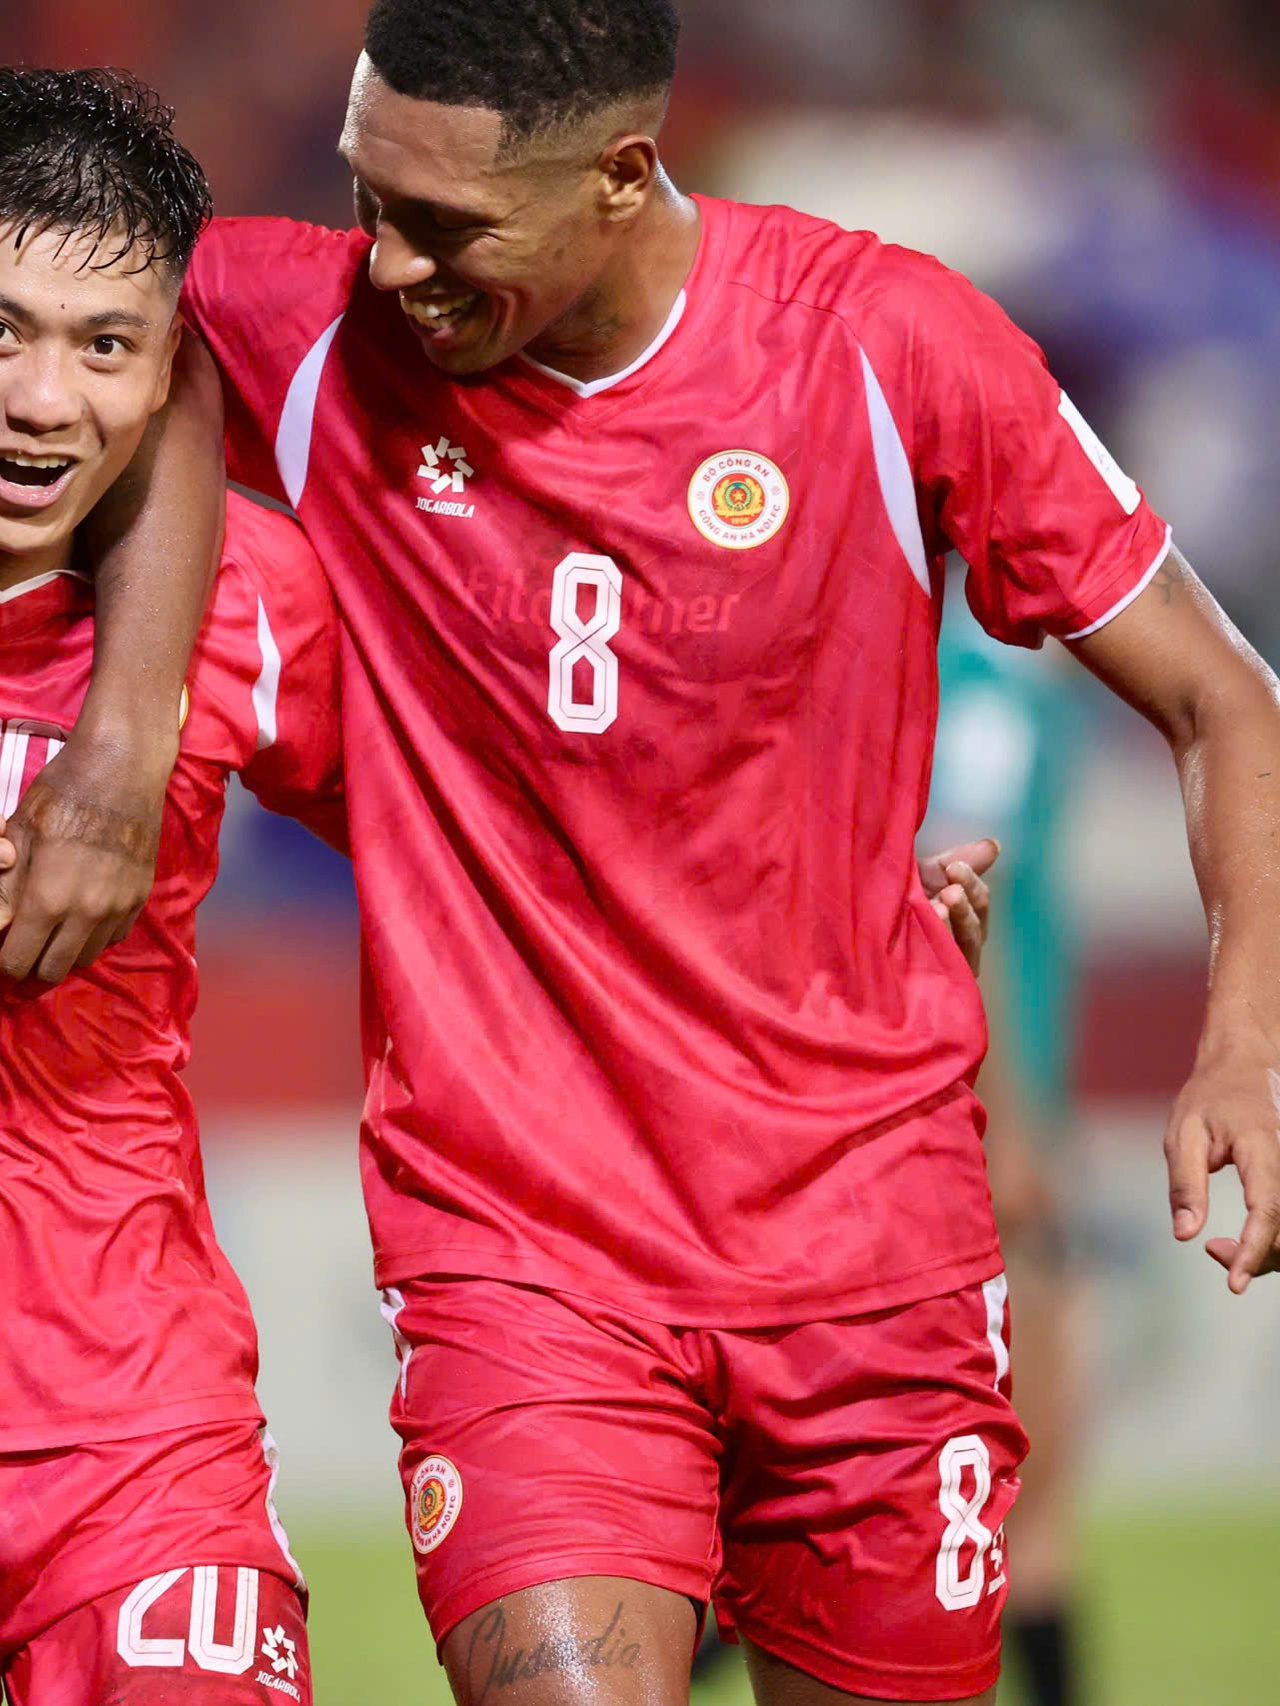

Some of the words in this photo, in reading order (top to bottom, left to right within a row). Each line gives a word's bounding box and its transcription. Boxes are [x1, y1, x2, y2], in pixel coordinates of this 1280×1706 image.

[718, 458, 751, 470] CÔNG
[754, 464, 770, 477] AN
[415, 497, 475, 518] JOGARBOLA
[722, 532, 737, 541] AN
[547, 552, 623, 734] 8
[935, 1434, 993, 1612] 8
[117, 1565, 259, 1675] 20
